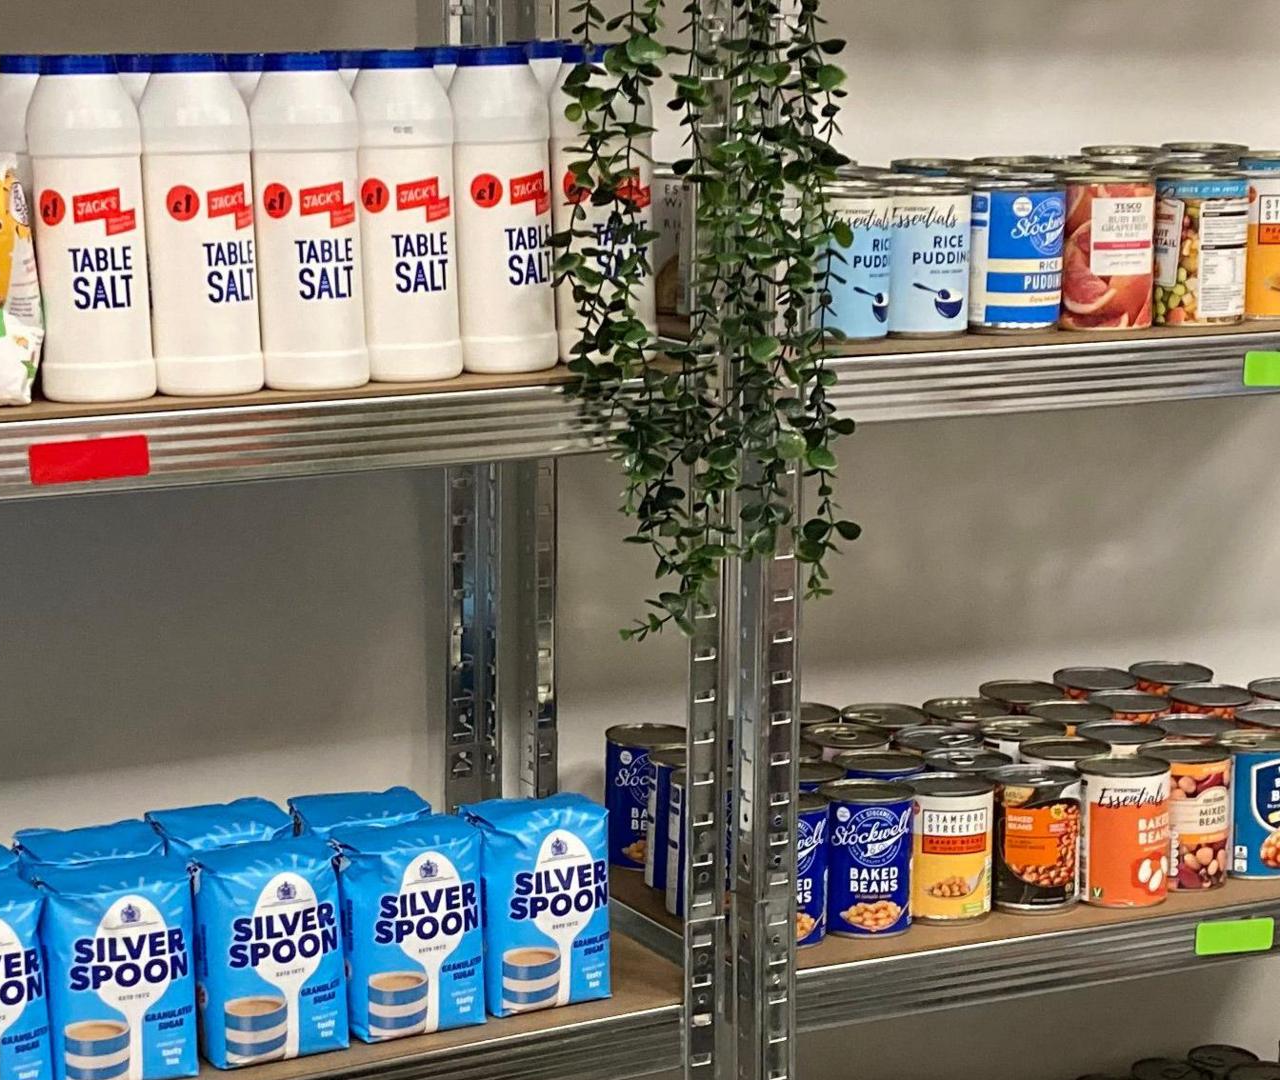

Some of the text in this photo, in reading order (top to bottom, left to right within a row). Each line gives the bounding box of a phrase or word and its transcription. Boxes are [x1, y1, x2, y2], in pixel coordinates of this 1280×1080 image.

[77, 198, 117, 215] JACK'S
[304, 190, 342, 208] JACK'S
[399, 185, 437, 203] JACK'S
[295, 238, 353, 264] TABLE
[392, 232, 448, 258] TABLE
[933, 235, 963, 248] RICE
[68, 246, 132, 272] TABLE
[1040, 260, 1058, 270] RICE
[299, 266, 353, 299] SALT
[395, 259, 448, 293] SALT
[73, 275, 133, 309] SALT
[1098, 783, 1165, 808] Essentials
[928, 813, 984, 824] STAMFORD
[1199, 816, 1225, 826] BEANS
[1200, 805, 1225, 816] MIXED
[831, 807, 912, 846] Stockwell
[928, 824, 969, 834] STREET
[515, 860, 607, 896] SILVER
[850, 867, 898, 880] BAKED
[850, 880, 898, 893] BEANS
[380, 882, 477, 919] SILVER
[509, 883, 608, 920] SPOON
[233, 902, 335, 941] SILVER
[375, 906, 479, 945] SPOON
[74, 928, 185, 963] SILVER
[229, 926, 338, 968] SPOON
[70, 952, 188, 991] SPOON
